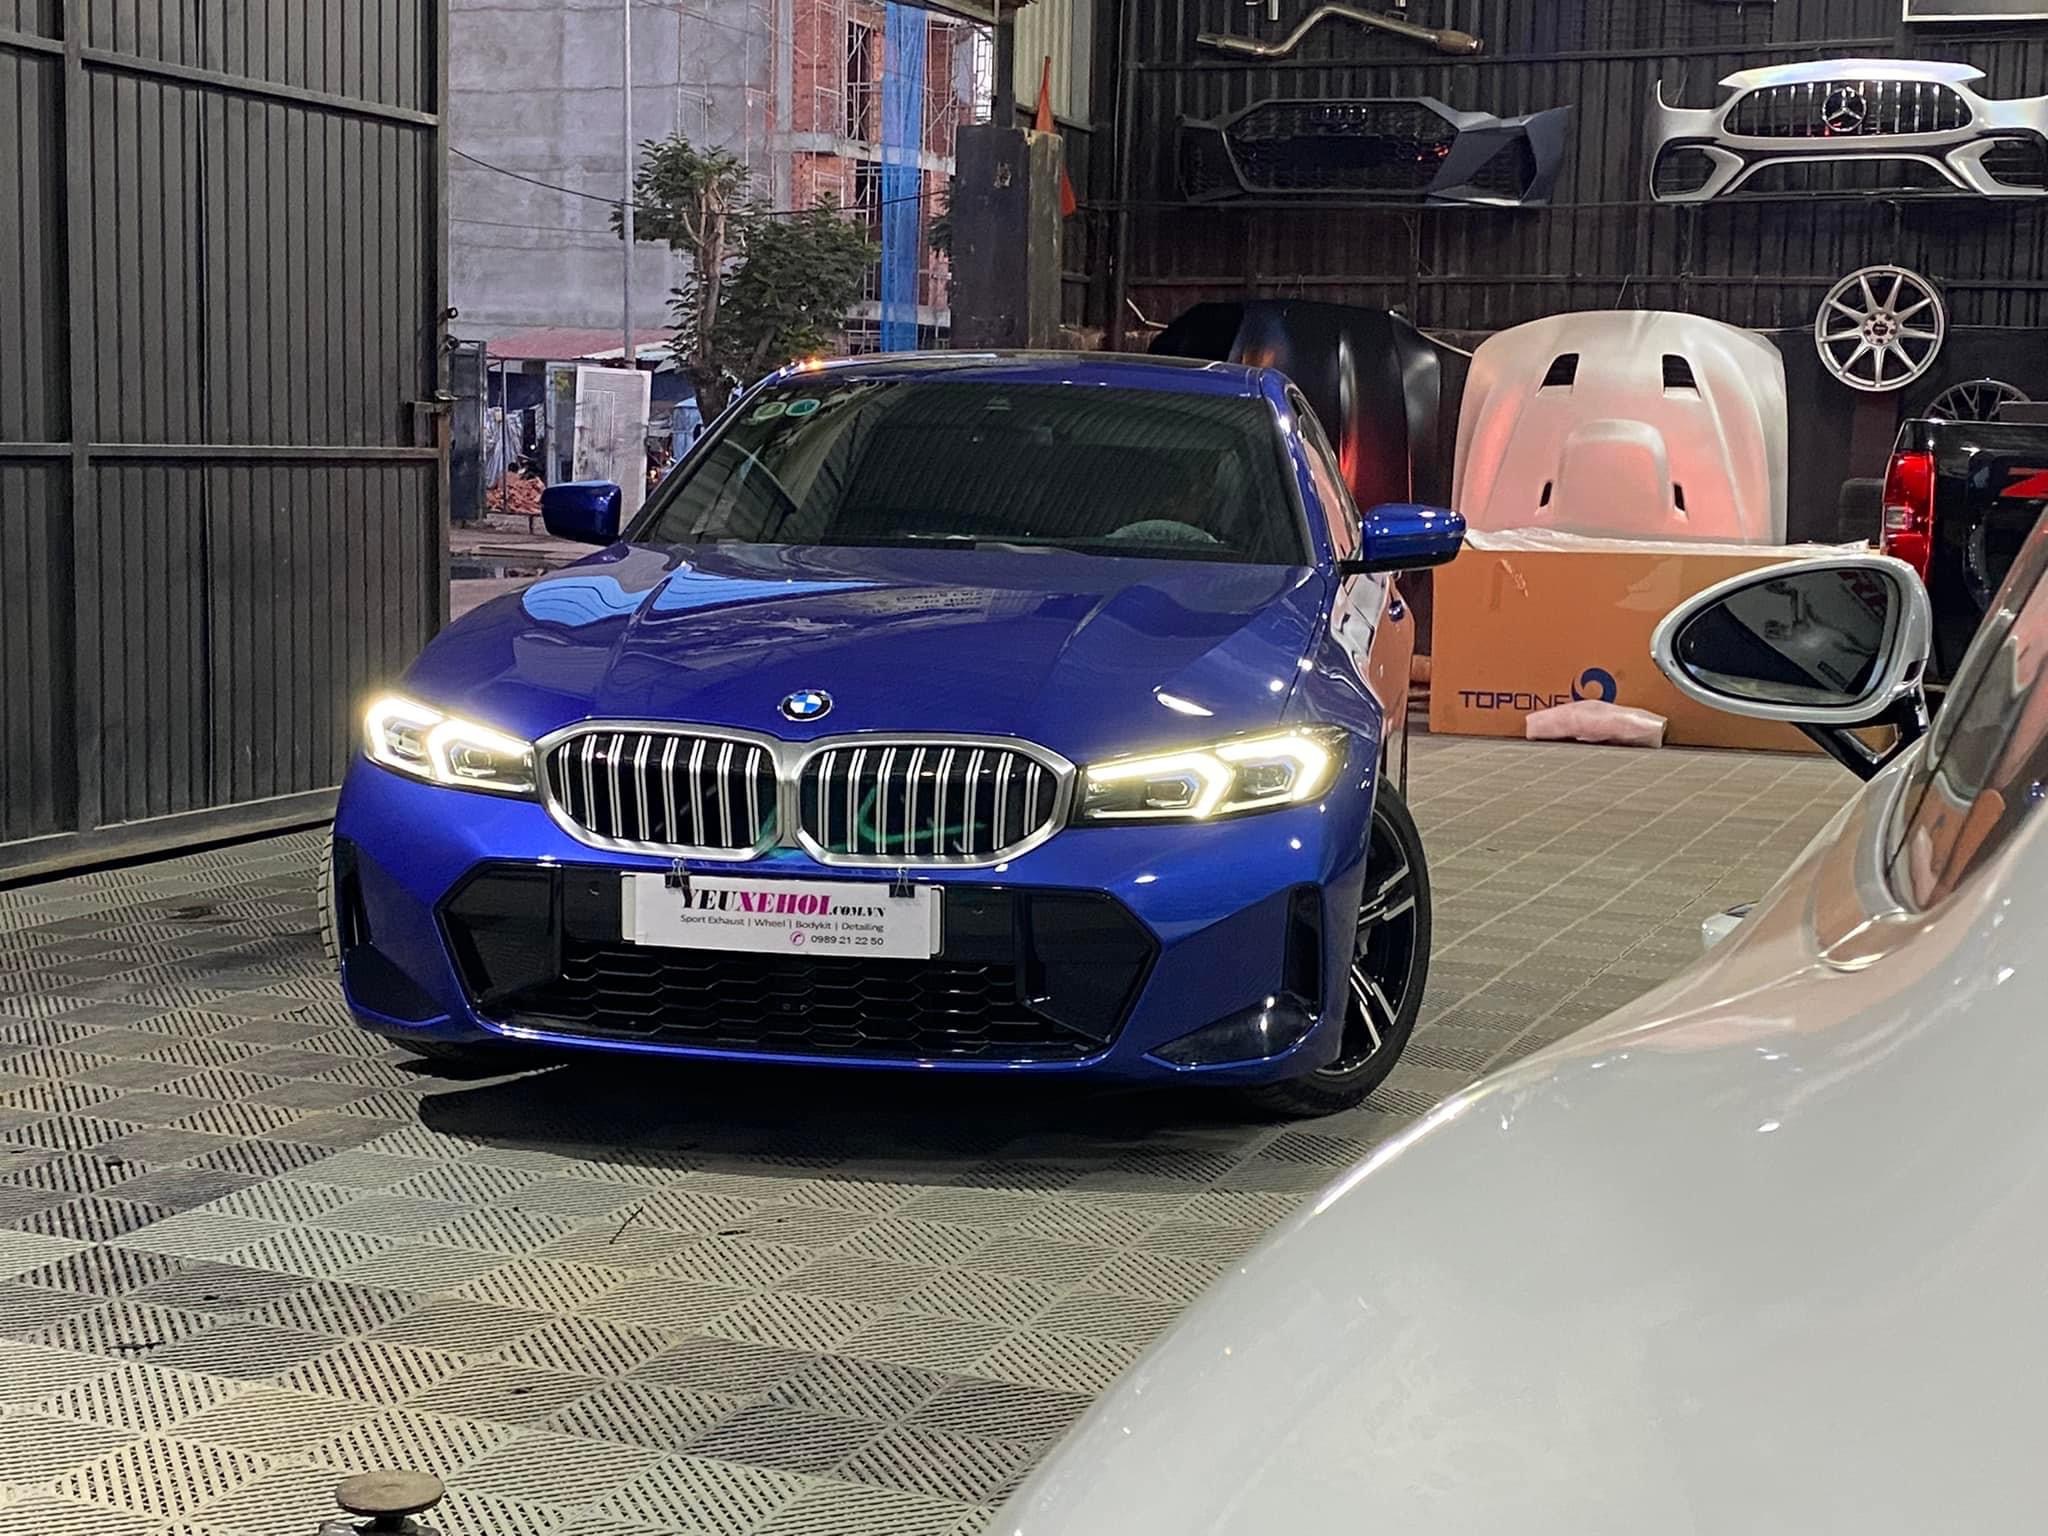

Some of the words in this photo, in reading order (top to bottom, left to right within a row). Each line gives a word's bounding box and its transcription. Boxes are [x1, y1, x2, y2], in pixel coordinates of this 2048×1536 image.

[681, 914, 706, 925] Sport
[708, 916, 745, 926] Exhaust
[754, 918, 786, 928] Wheel
[796, 920, 832, 930] Bodykit
[841, 922, 885, 933] Detailing
[811, 935, 838, 944] 0989
[838, 936, 852, 945] 21
[855, 937, 869, 946] 22
[870, 937, 885, 946] 50
